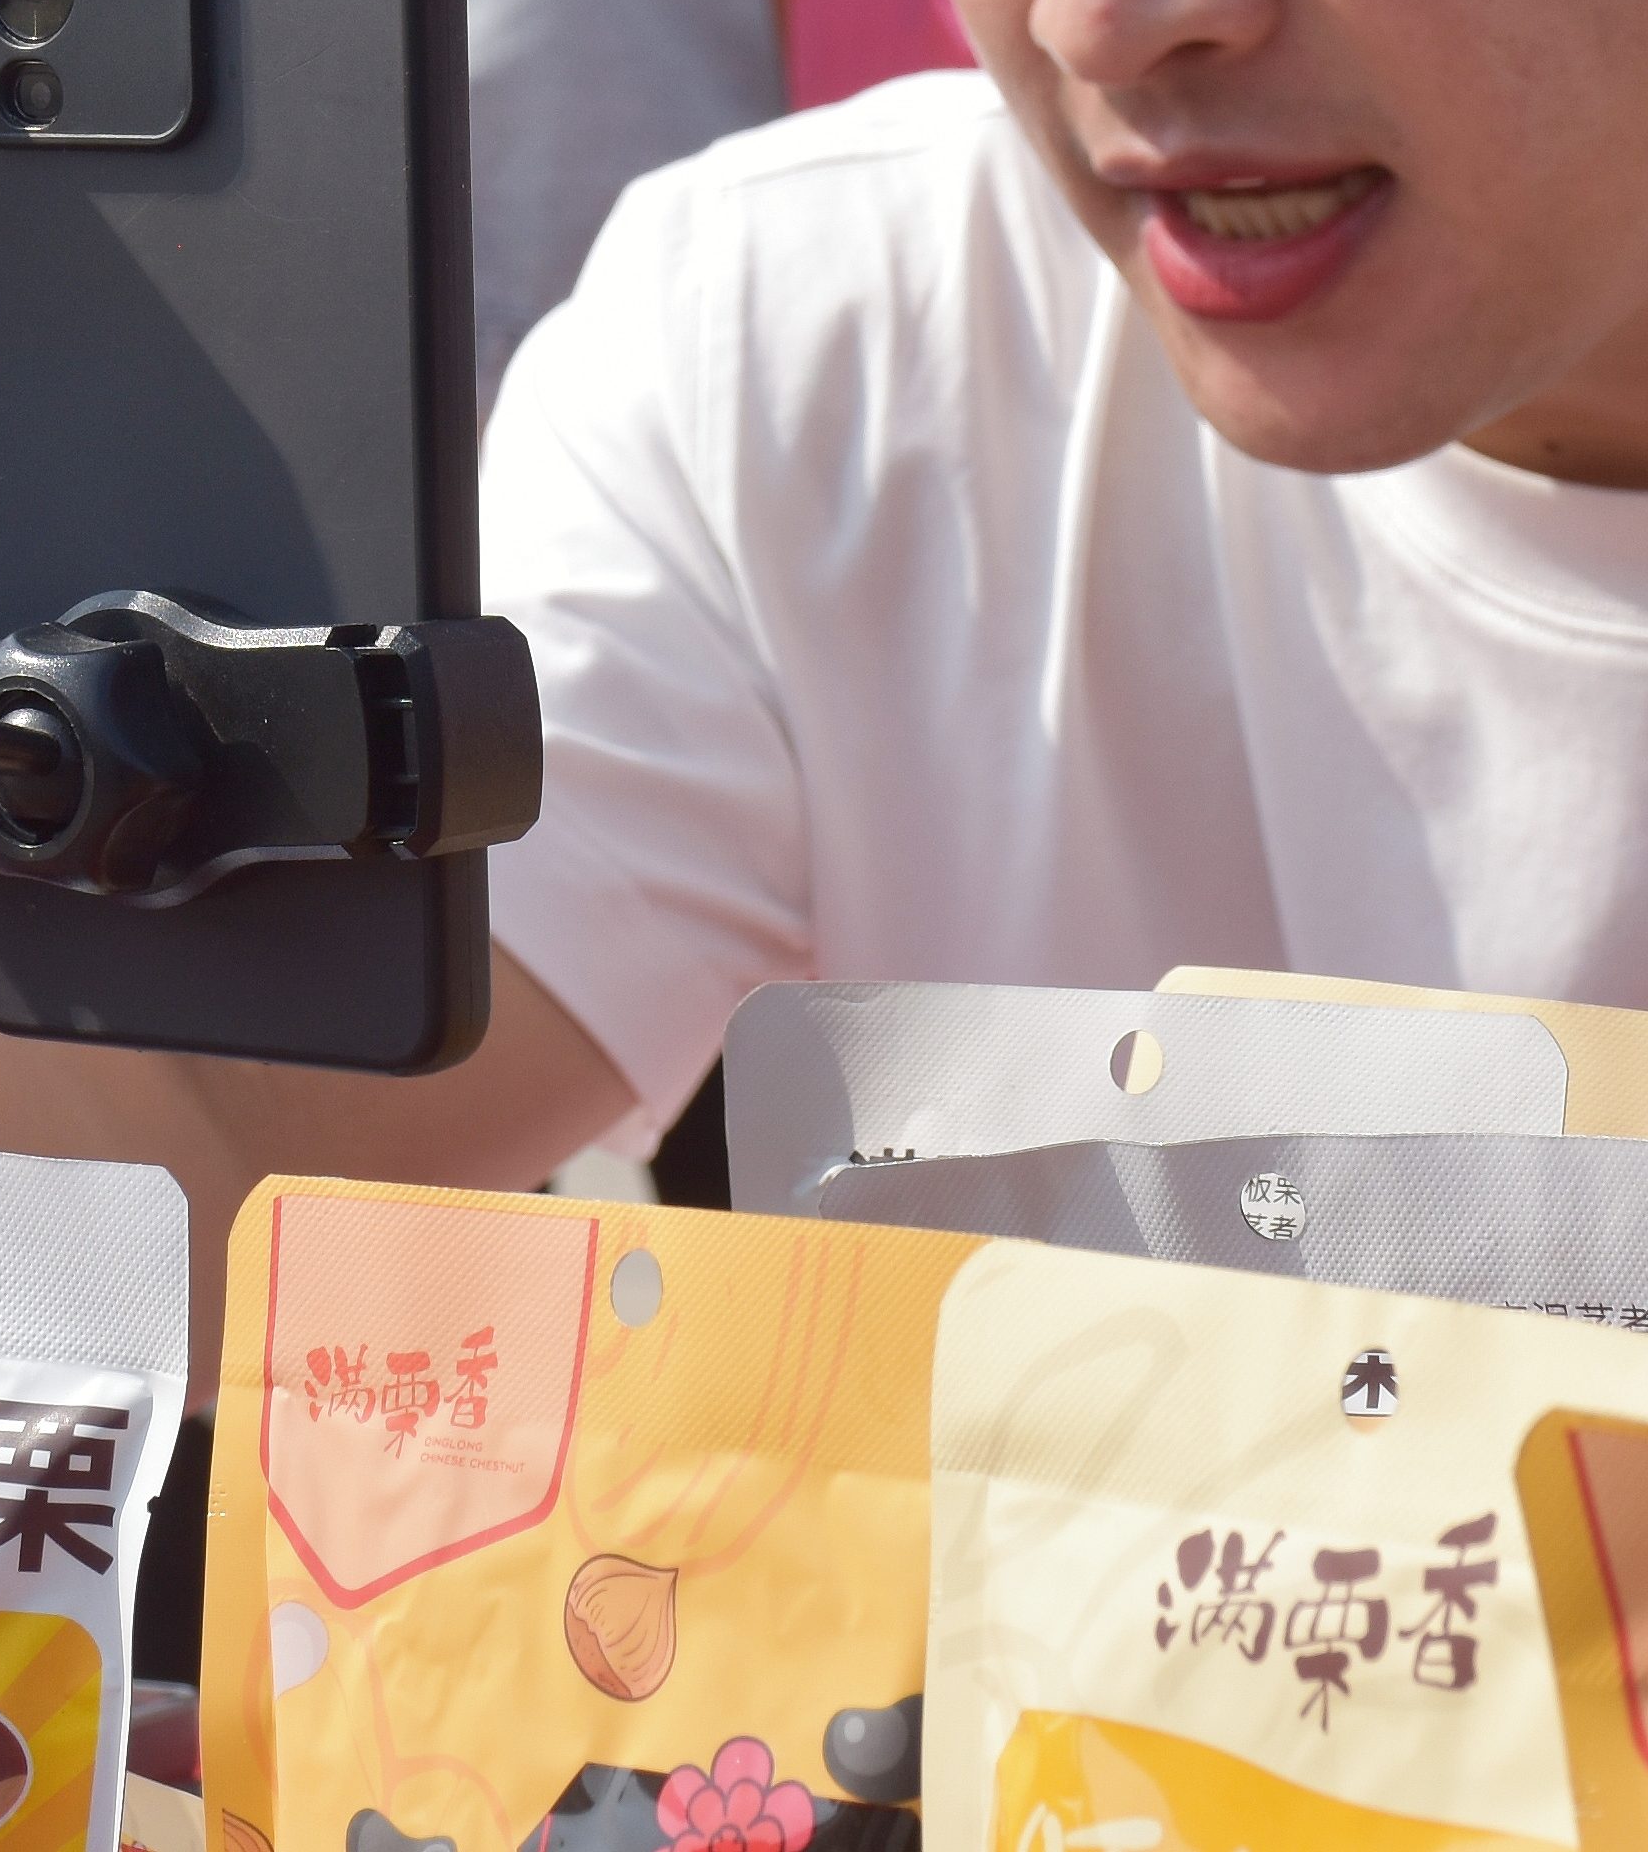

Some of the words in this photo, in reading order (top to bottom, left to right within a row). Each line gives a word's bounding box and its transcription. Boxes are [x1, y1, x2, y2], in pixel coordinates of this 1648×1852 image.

[304, 1326, 498, 1459] 满栗香
[420, 1452, 466, 1468] CHINESE
[469, 1456, 527, 1473] CHESTNUT
[1154, 1510, 1500, 1732] 满栗香
